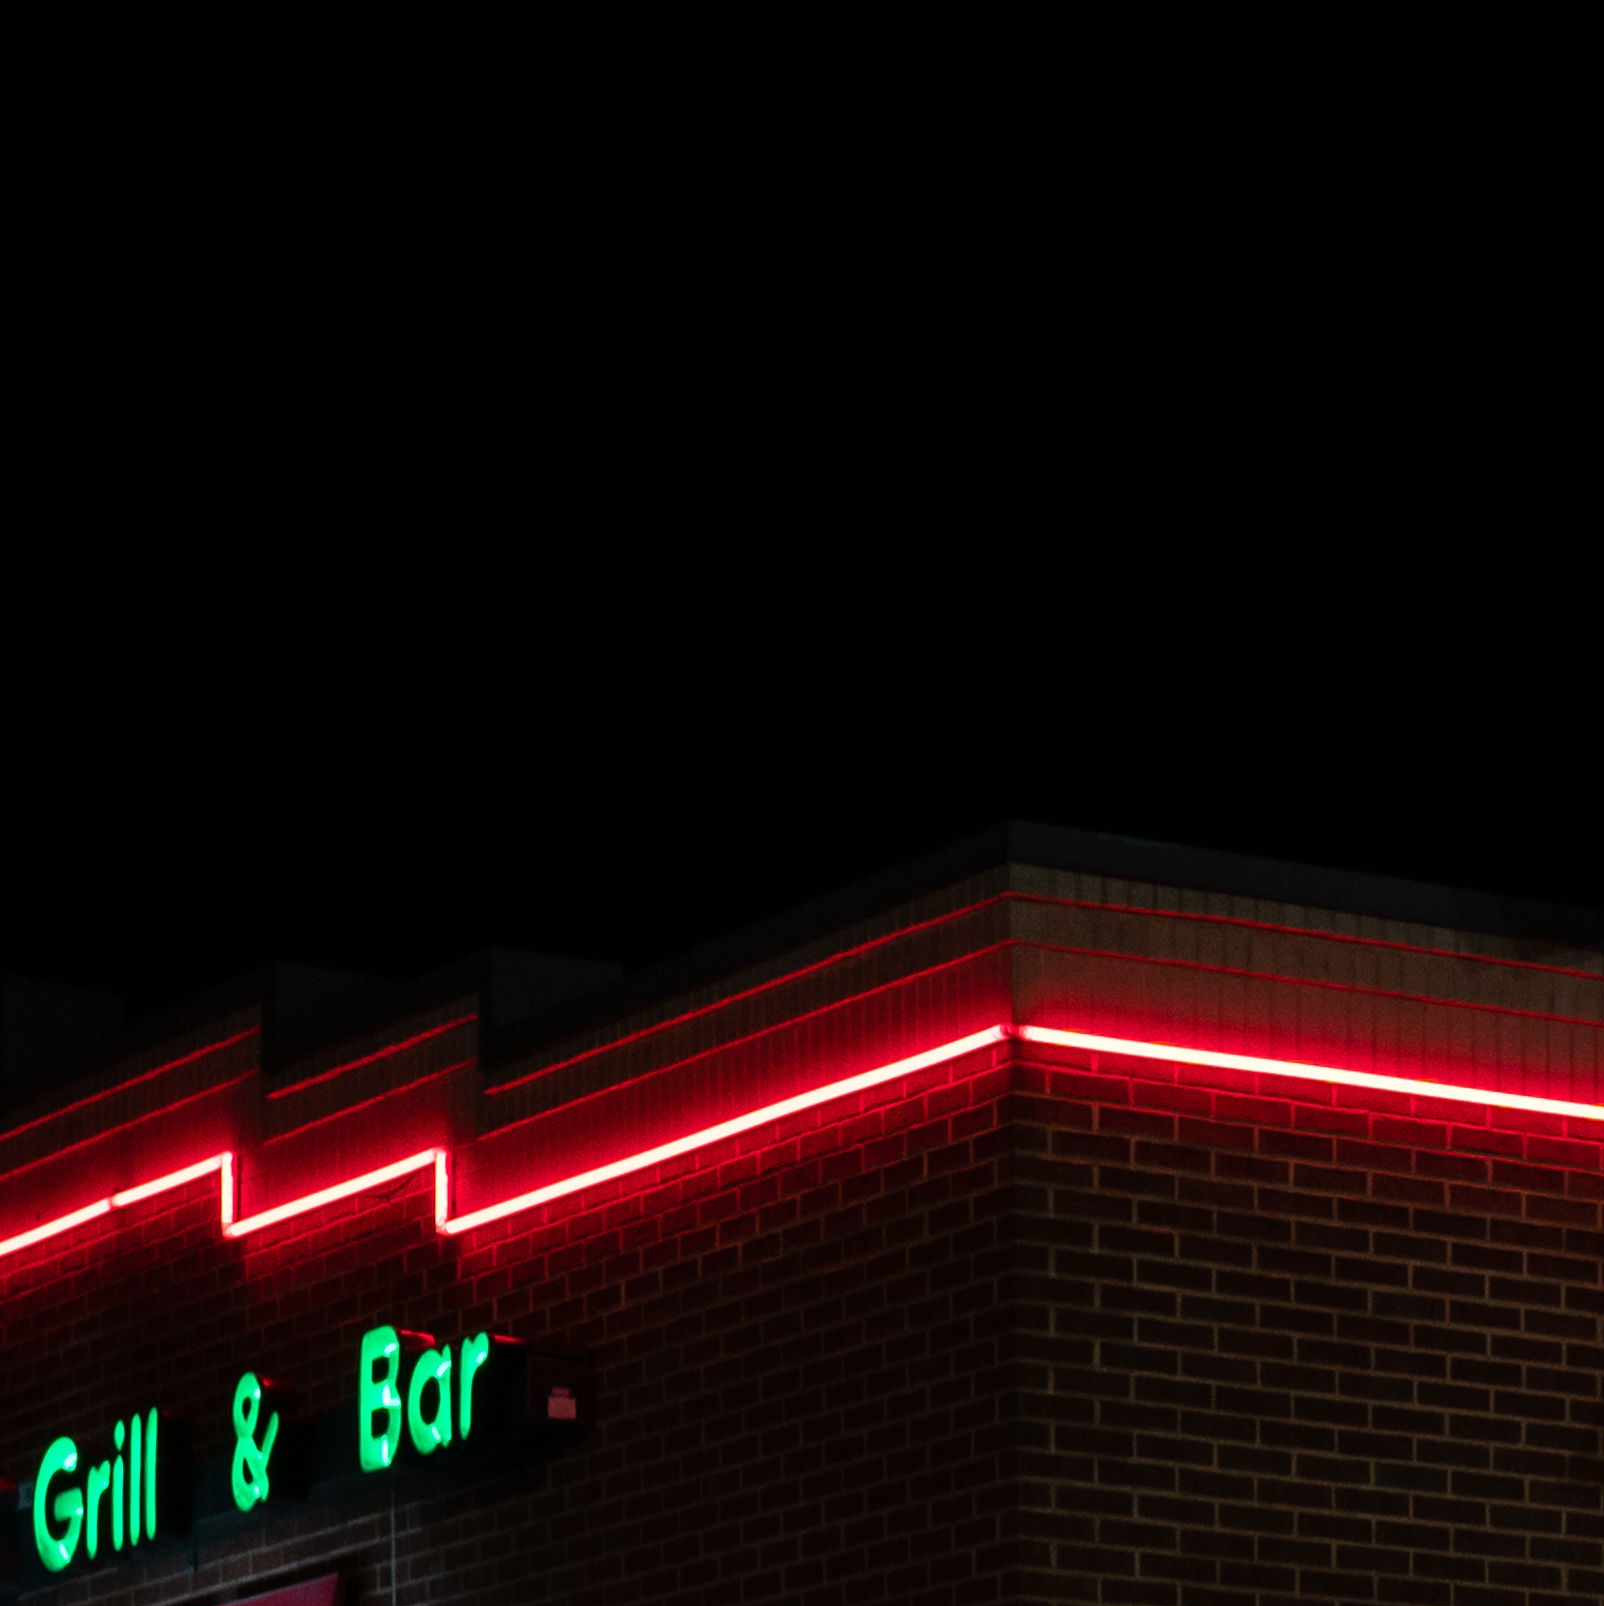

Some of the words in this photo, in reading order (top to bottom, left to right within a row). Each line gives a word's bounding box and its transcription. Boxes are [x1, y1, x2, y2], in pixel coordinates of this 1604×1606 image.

[34, 1407, 158, 1571] Grill
[231, 1372, 279, 1511] &
[360, 1325, 489, 1471] Bar
